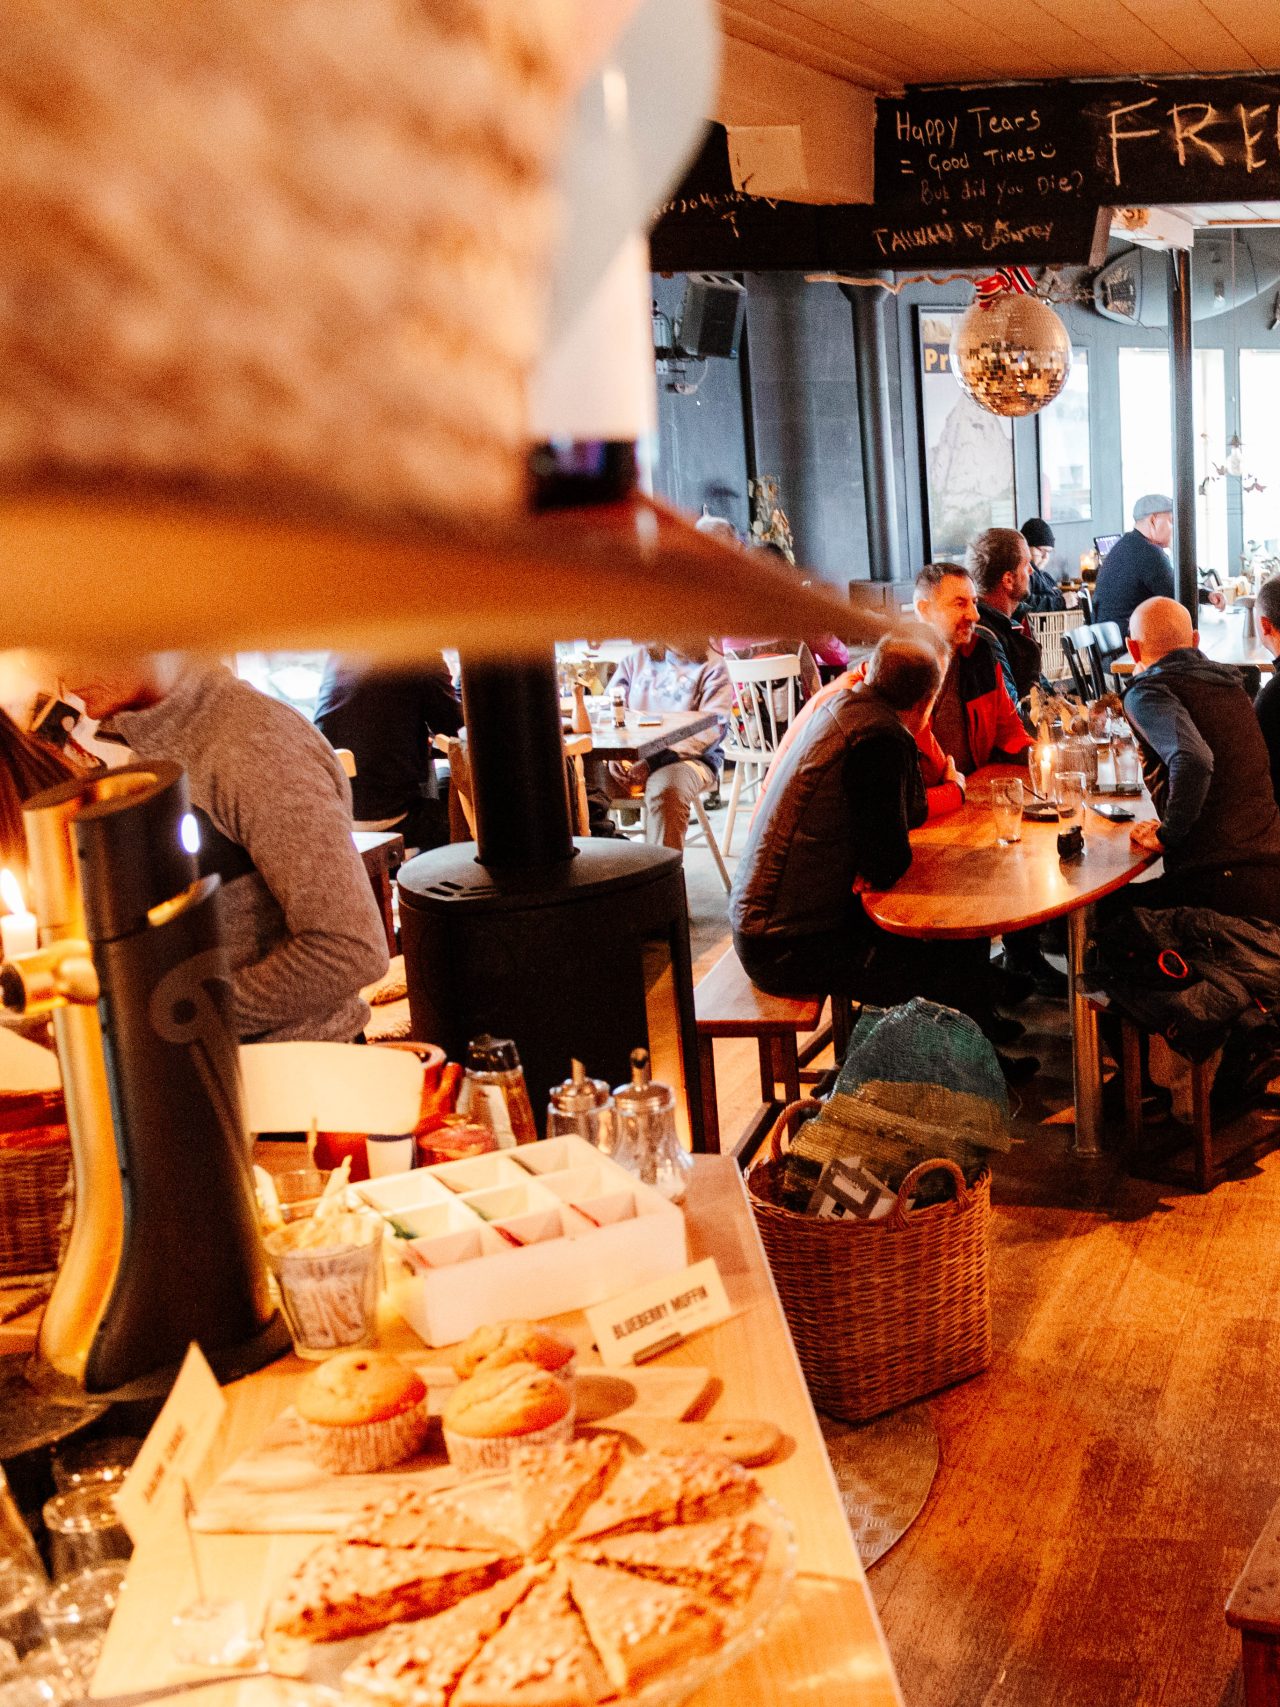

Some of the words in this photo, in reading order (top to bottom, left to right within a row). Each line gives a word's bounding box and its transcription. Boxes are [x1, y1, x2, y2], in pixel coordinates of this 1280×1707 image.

[896, 111, 958, 149] Happy
[967, 106, 1041, 138] Tears
[928, 152, 970, 180] Good
[961, 180, 986, 199] did
